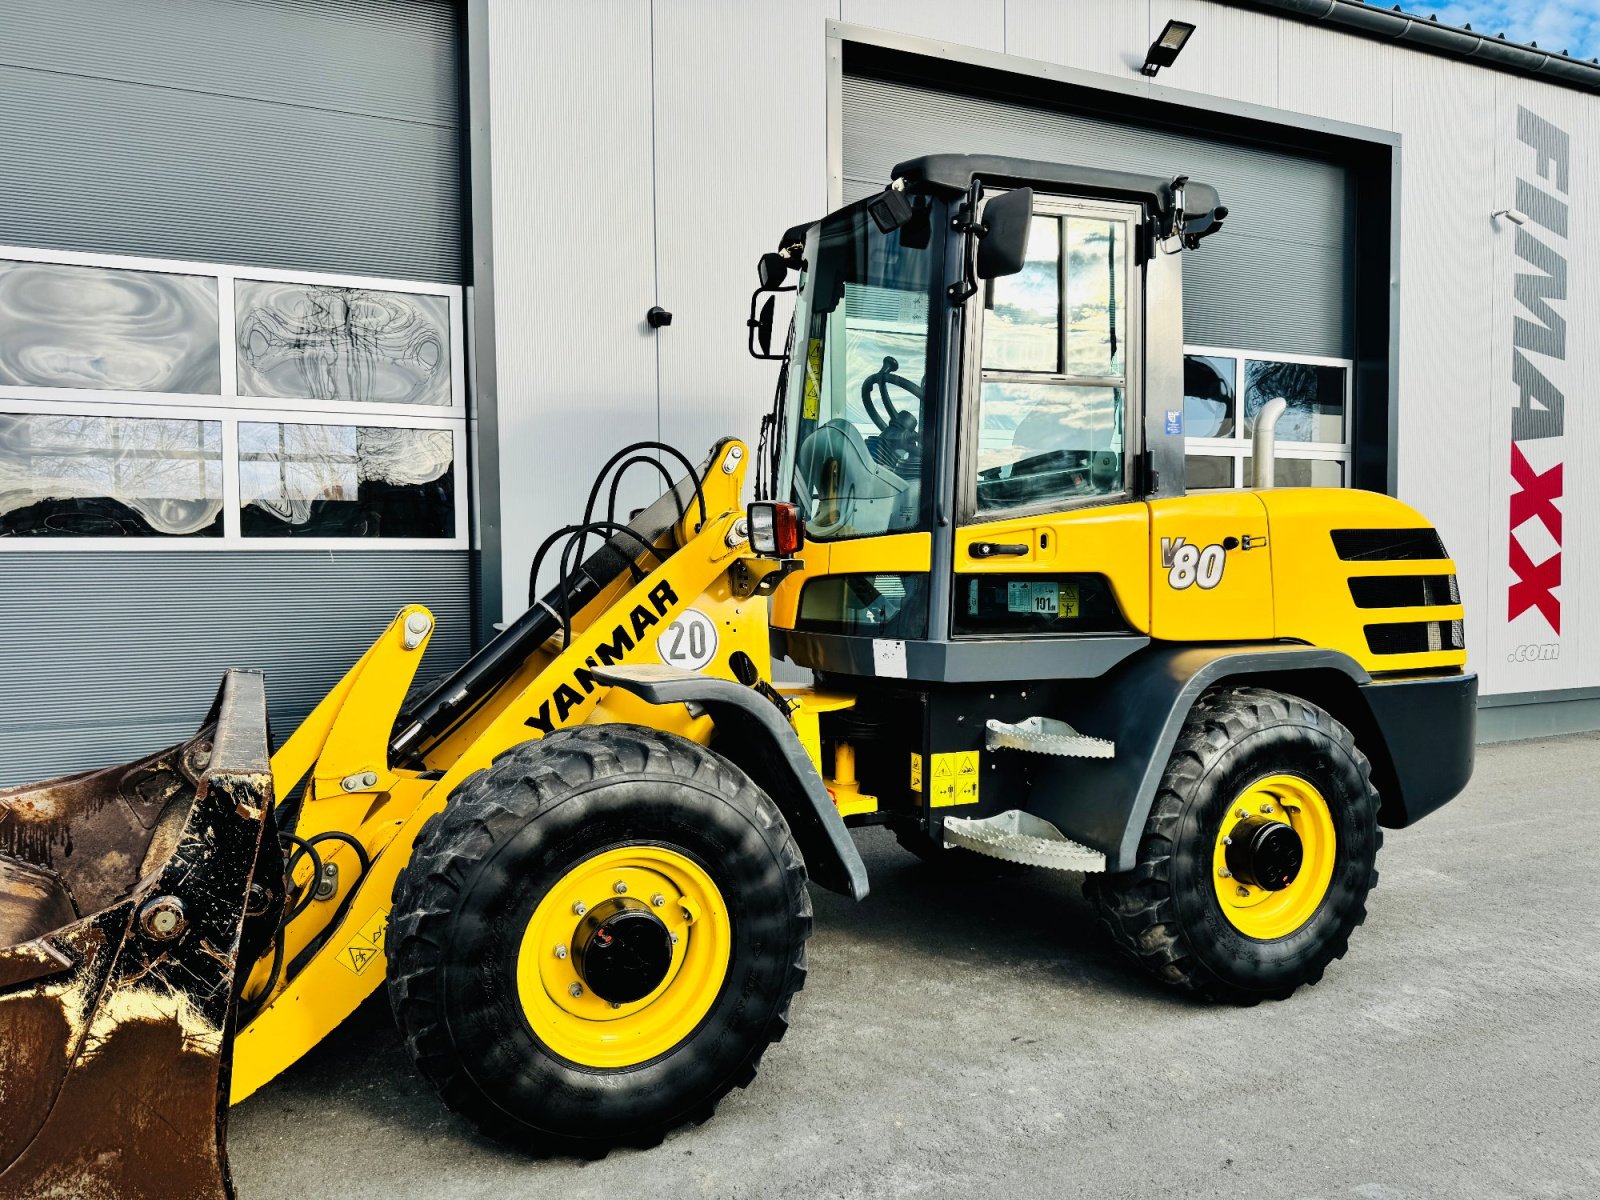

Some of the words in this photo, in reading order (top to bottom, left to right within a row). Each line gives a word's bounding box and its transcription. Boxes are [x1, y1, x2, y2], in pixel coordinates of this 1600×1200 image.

[1508, 104, 1570, 637] FIMAXX
[1161, 537, 1226, 590] V80
[524, 579, 679, 734] YANMAR
[668, 620, 706, 660] 20
[1507, 643, 1560, 662] .com
